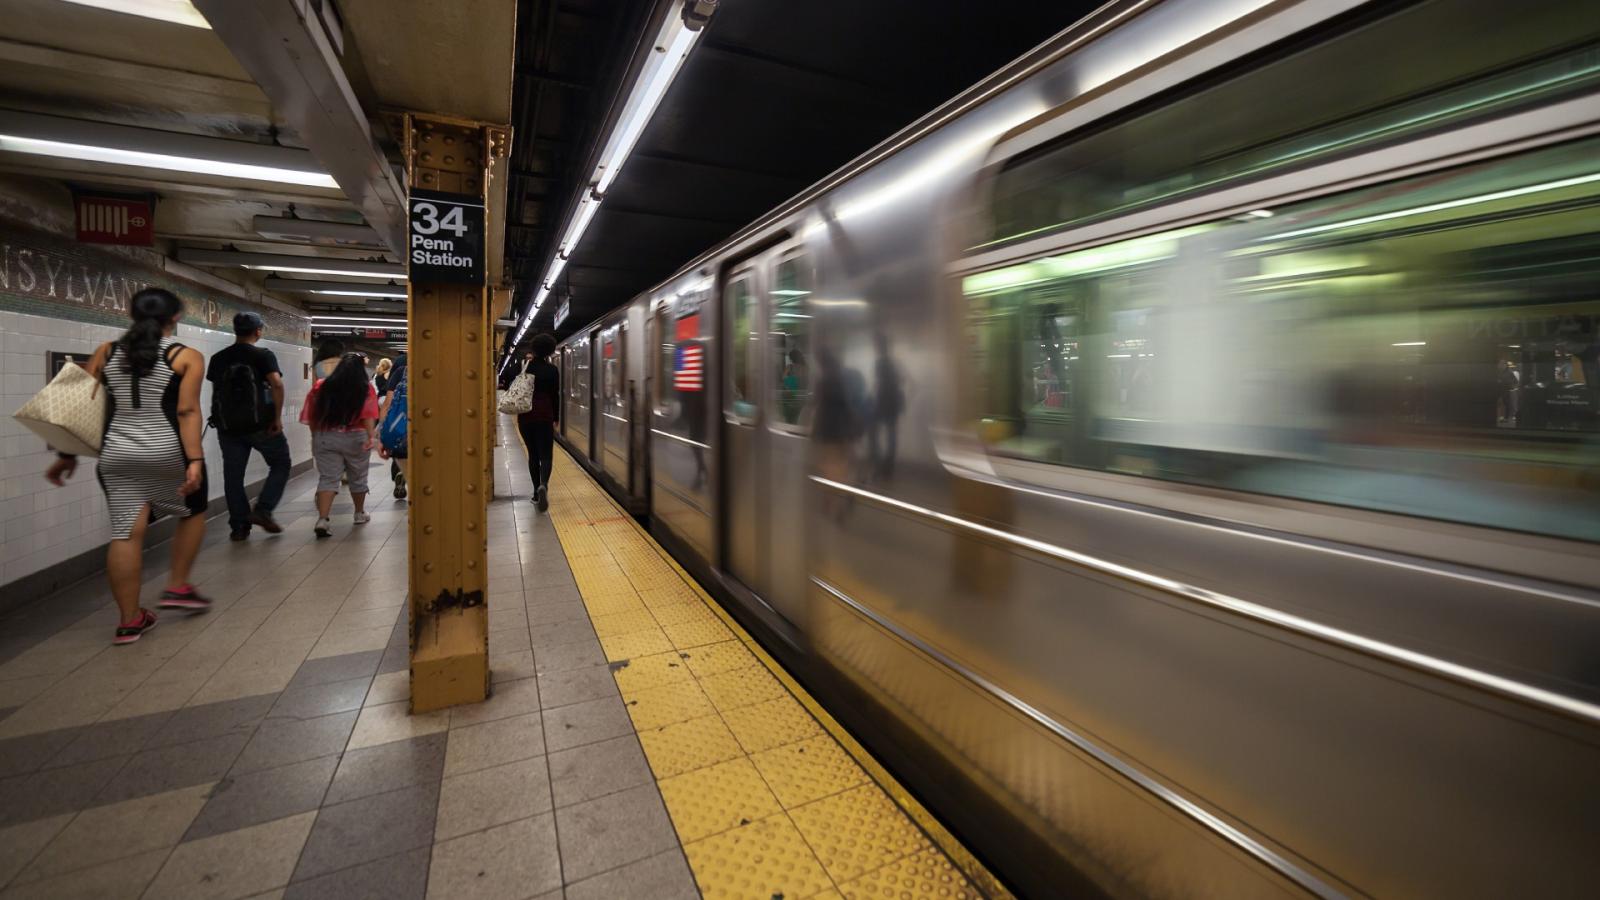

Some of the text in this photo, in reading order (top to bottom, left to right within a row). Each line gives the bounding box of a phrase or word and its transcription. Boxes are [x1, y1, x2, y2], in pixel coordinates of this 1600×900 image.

[412, 202, 468, 237] 34
[412, 234, 454, 251] Penn
[412, 249, 473, 268] Station
[0, 245, 148, 311] NSYLVAN
